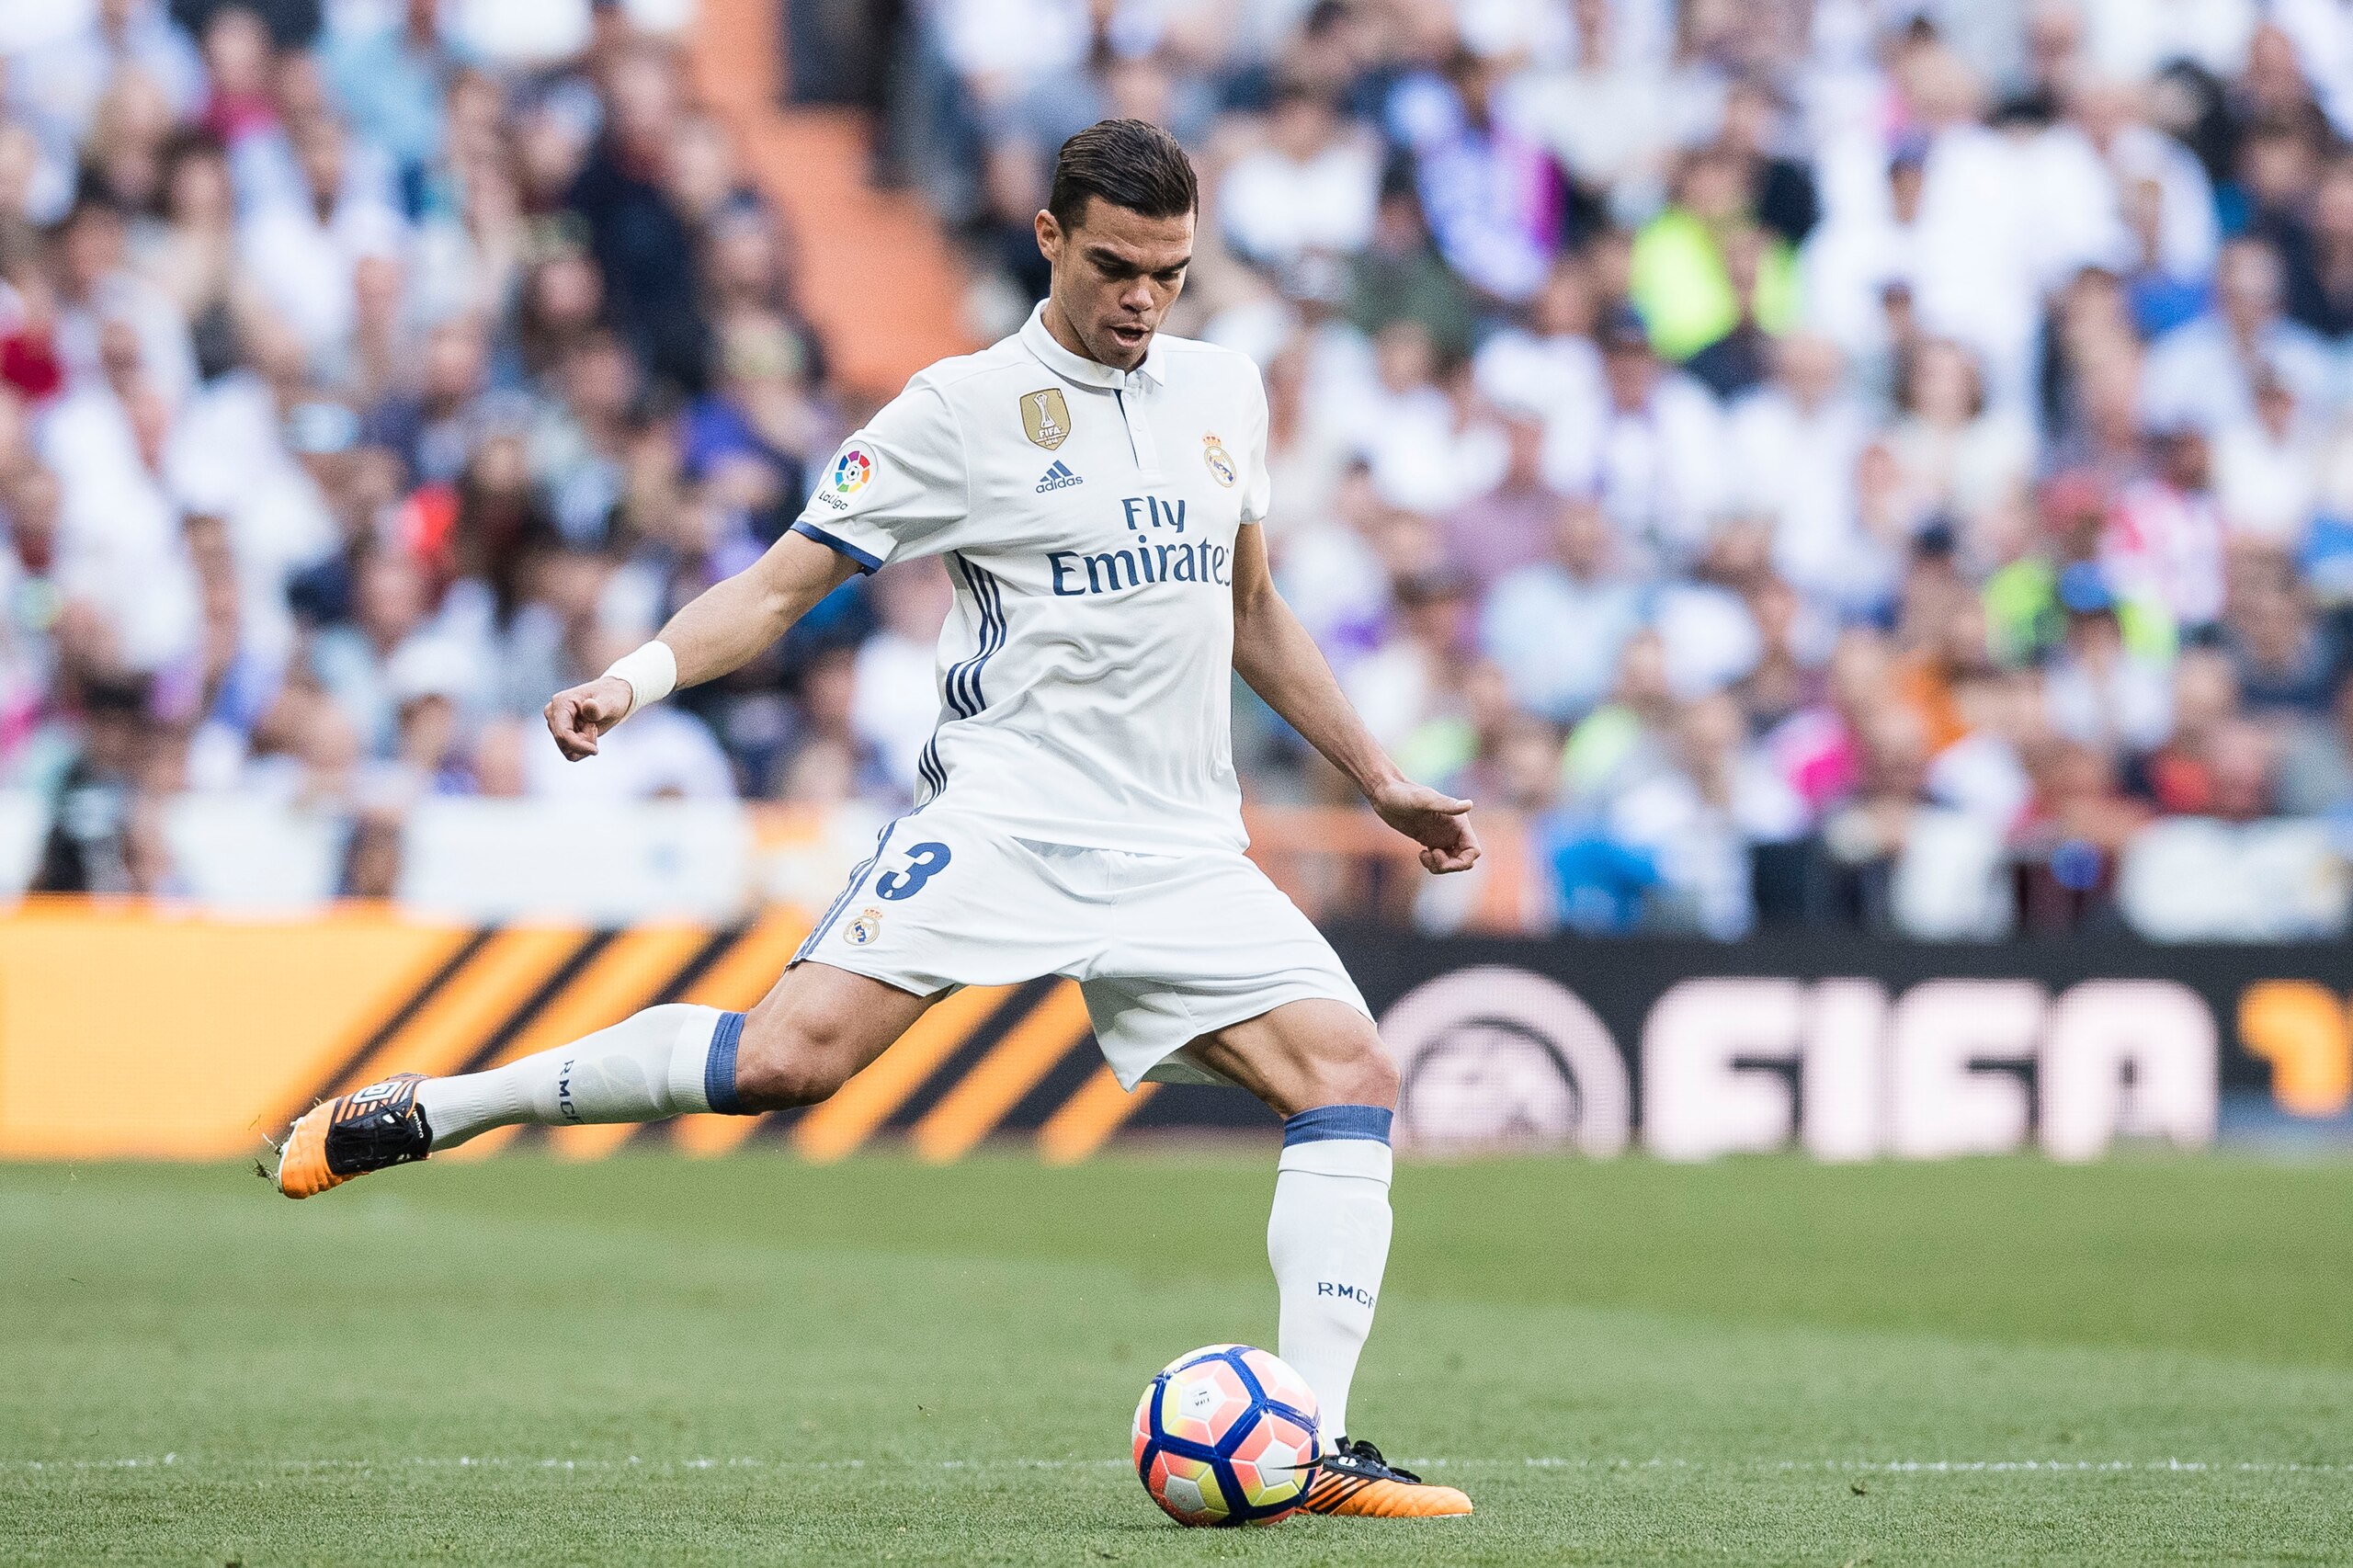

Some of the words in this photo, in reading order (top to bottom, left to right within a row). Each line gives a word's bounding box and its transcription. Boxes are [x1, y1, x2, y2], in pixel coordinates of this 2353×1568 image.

[1038, 426, 1062, 438] FIFA
[1035, 476, 1084, 494] adidas
[818, 490, 848, 511] LaLiga
[1121, 495, 1186, 534] Fly
[875, 842, 952, 901] 3
[1642, 977, 2219, 1163] FIFA
[2237, 978, 2353, 1117] 1
